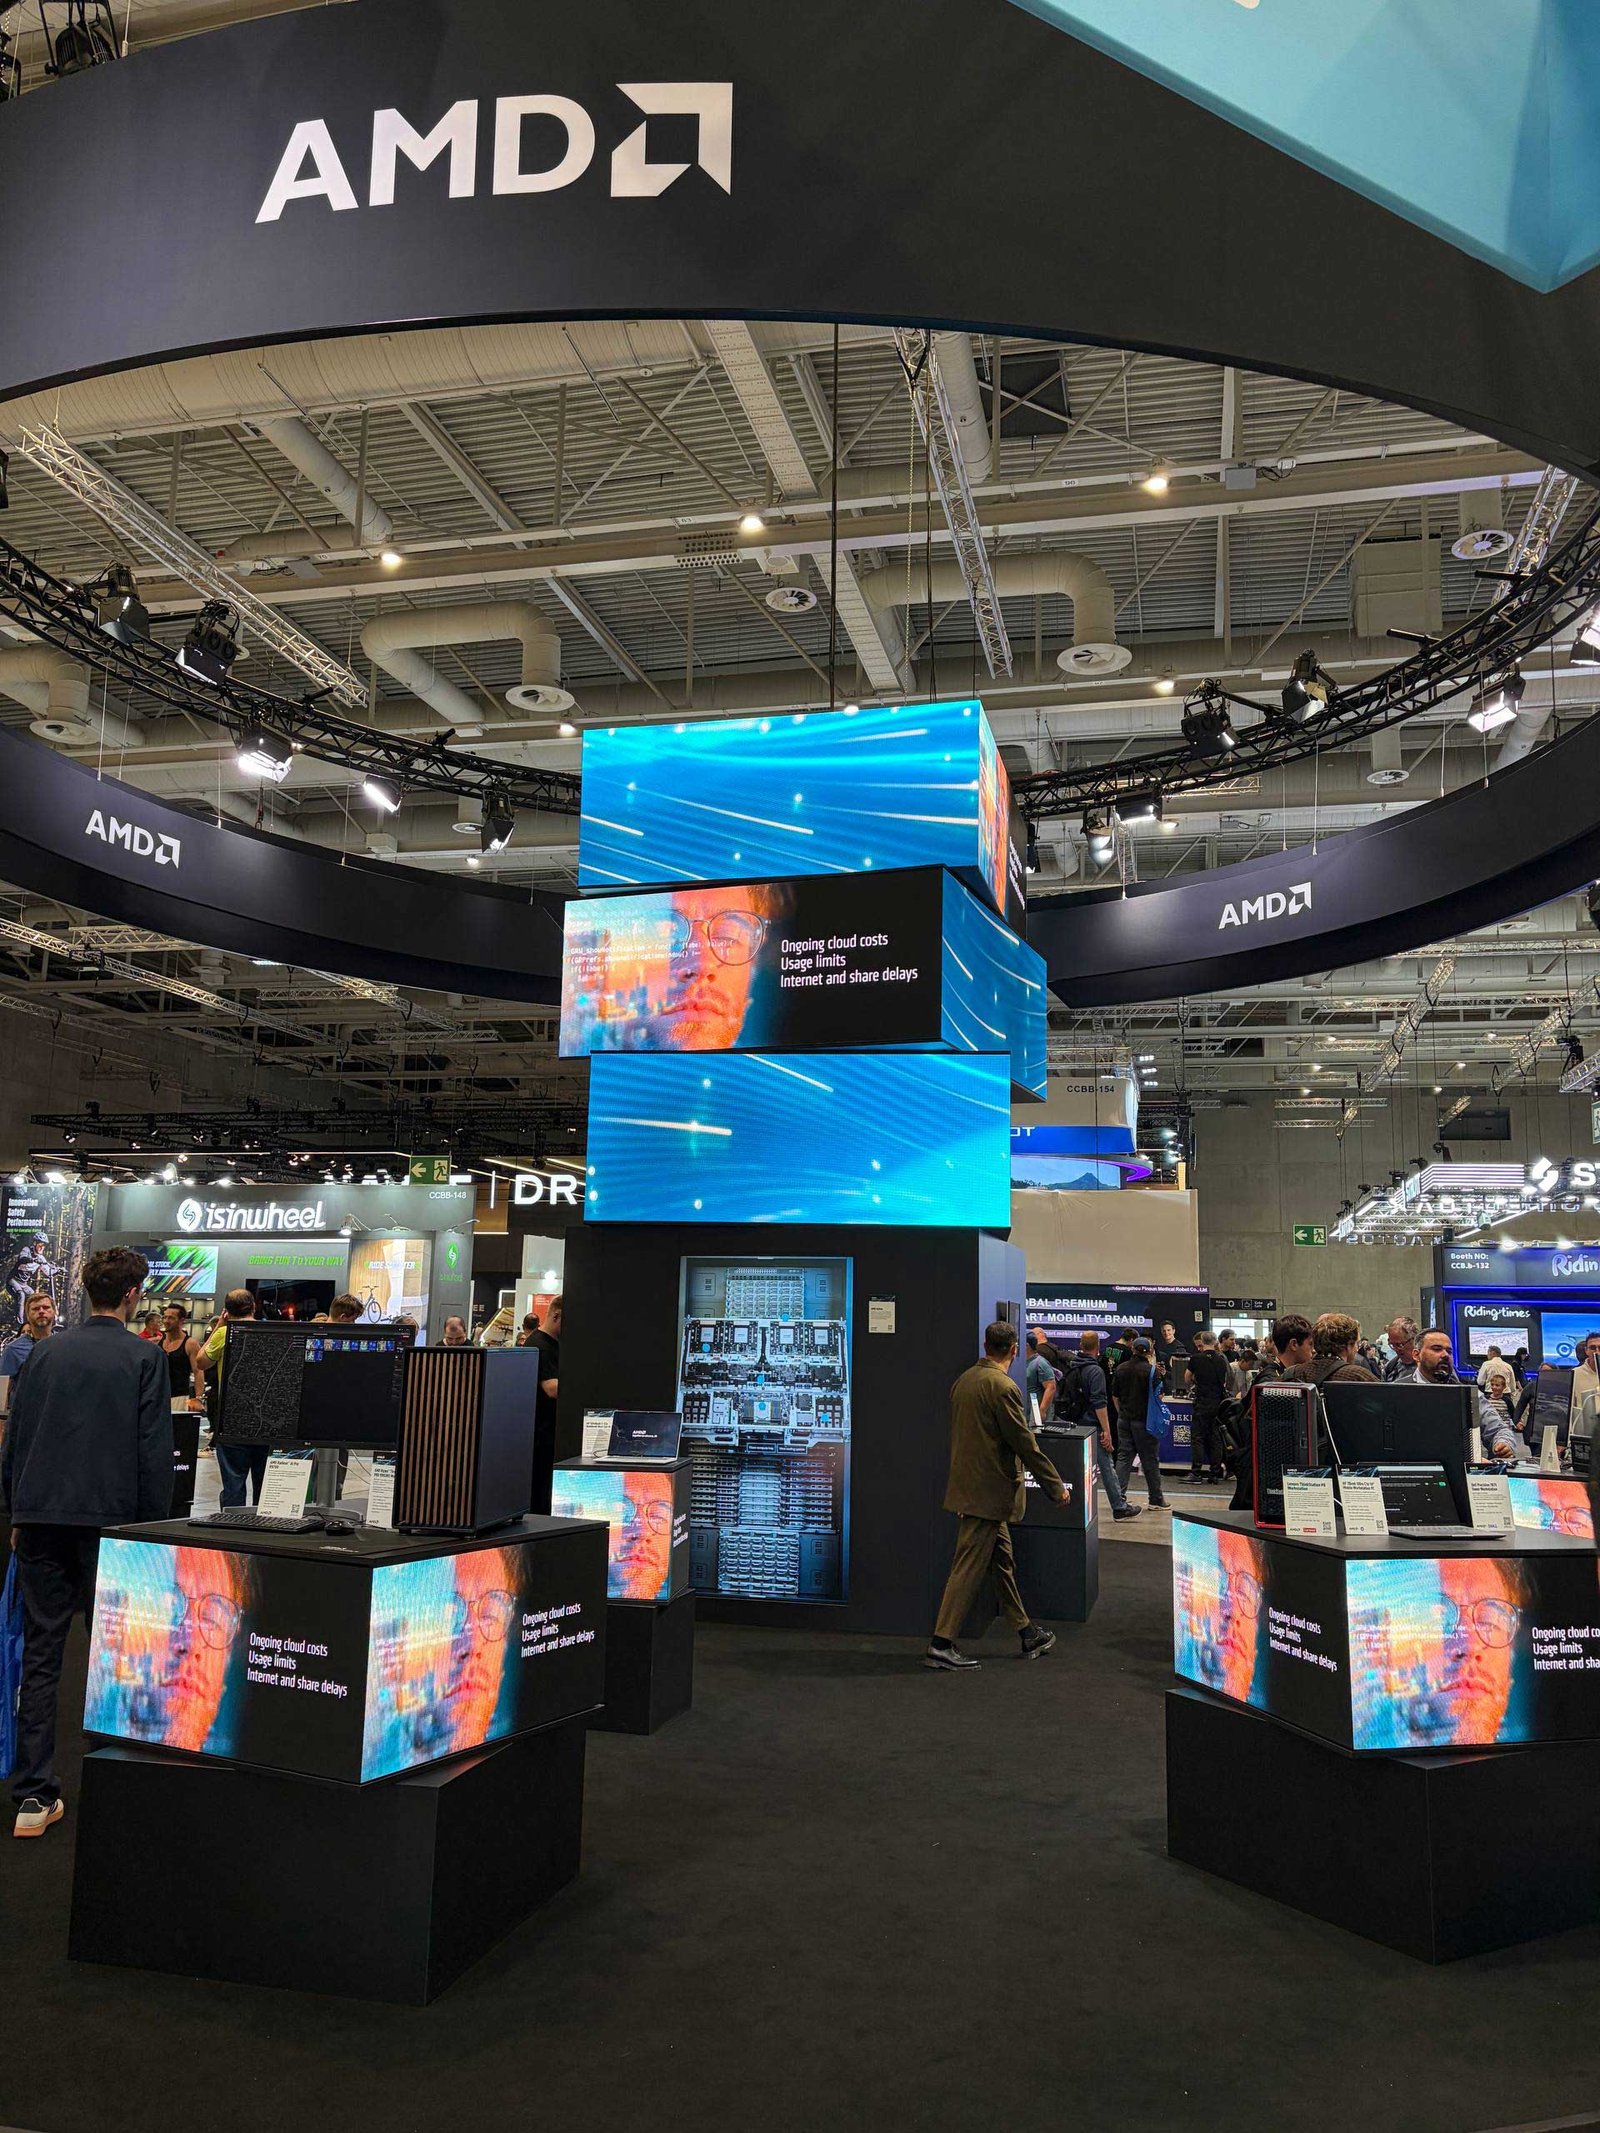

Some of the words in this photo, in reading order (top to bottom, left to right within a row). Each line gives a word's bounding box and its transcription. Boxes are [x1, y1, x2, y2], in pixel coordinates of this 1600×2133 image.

[254, 94, 596, 224] AMD
[84, 809, 155, 856] AMD
[1218, 892, 1288, 930] AMD
[781, 937, 826, 955] Ongoing
[827, 933, 857, 951] cloud
[859, 933, 889, 947] costs
[780, 956, 813, 972] Usage
[815, 953, 846, 968] limits
[780, 973, 824, 988] Internet
[825, 970, 847, 985] and
[849, 969, 880, 984] share
[882, 966, 918, 983] delays
[1066, 1085, 1115, 1093] CCBB-154
[429, 1191, 467, 1199] CCBB-148
[514, 1174, 578, 1205] DR
[8, 1198, 39, 1207] Innovation
[8, 1208, 26, 1218] Safety
[6, 1218, 43, 1227] Performance
[206, 1201, 327, 1230] isinwheel
[248, 1255, 274, 1265] BRING
[274, 1255, 290, 1265] FUN
[304, 1255, 325, 1266] YOUR
[326, 1255, 346, 1266] WAY
[1055, 1299, 1108, 1309] PREMIUM
[1048, 1313, 1101, 1323] MOBILITY
[1104, 1315, 1145, 1324] BRAND
[522, 1610, 548, 1627] Ongoing
[548, 1605, 565, 1620] cloud
[565, 1602, 581, 1616] costs
[1268, 1606, 1291, 1627] Ongoing
[1290, 1613, 1306, 1630] cloud
[1306, 1617, 1322, 1635] costs
[521, 1627, 541, 1642] Usage
[541, 1623, 559, 1638] limits
[1268, 1622, 1286, 1640] Usage
[1285, 1627, 1301, 1643] limits
[1531, 1626, 1566, 1641] Ongoing
[1567, 1625, 1590, 1638] cloud
[249, 1632, 282, 1653] Ongoing
[283, 1636, 306, 1654] cloud
[306, 1641, 328, 1657] costs
[521, 1641, 546, 1658] Internet
[546, 1636, 558, 1651] and
[559, 1633, 576, 1648] share
[576, 1629, 595, 1645] delays
[1269, 1636, 1291, 1655] Internet
[1291, 1643, 1302, 1658] and
[1302, 1647, 1318, 1665] share
[1318, 1653, 1337, 1672] delays
[1532, 1642, 1558, 1657] Usage
[1559, 1641, 1583, 1654] limits
[248, 1649, 273, 1669] Usage
[273, 1655, 297, 1671] limits
[1533, 1658, 1567, 1671] Internet
[1568, 1656, 1584, 1670] and
[246, 1667, 279, 1686] Internet
[280, 1672, 296, 1689] and
[296, 1675, 320, 1692] share
[321, 1680, 348, 1699] delays
